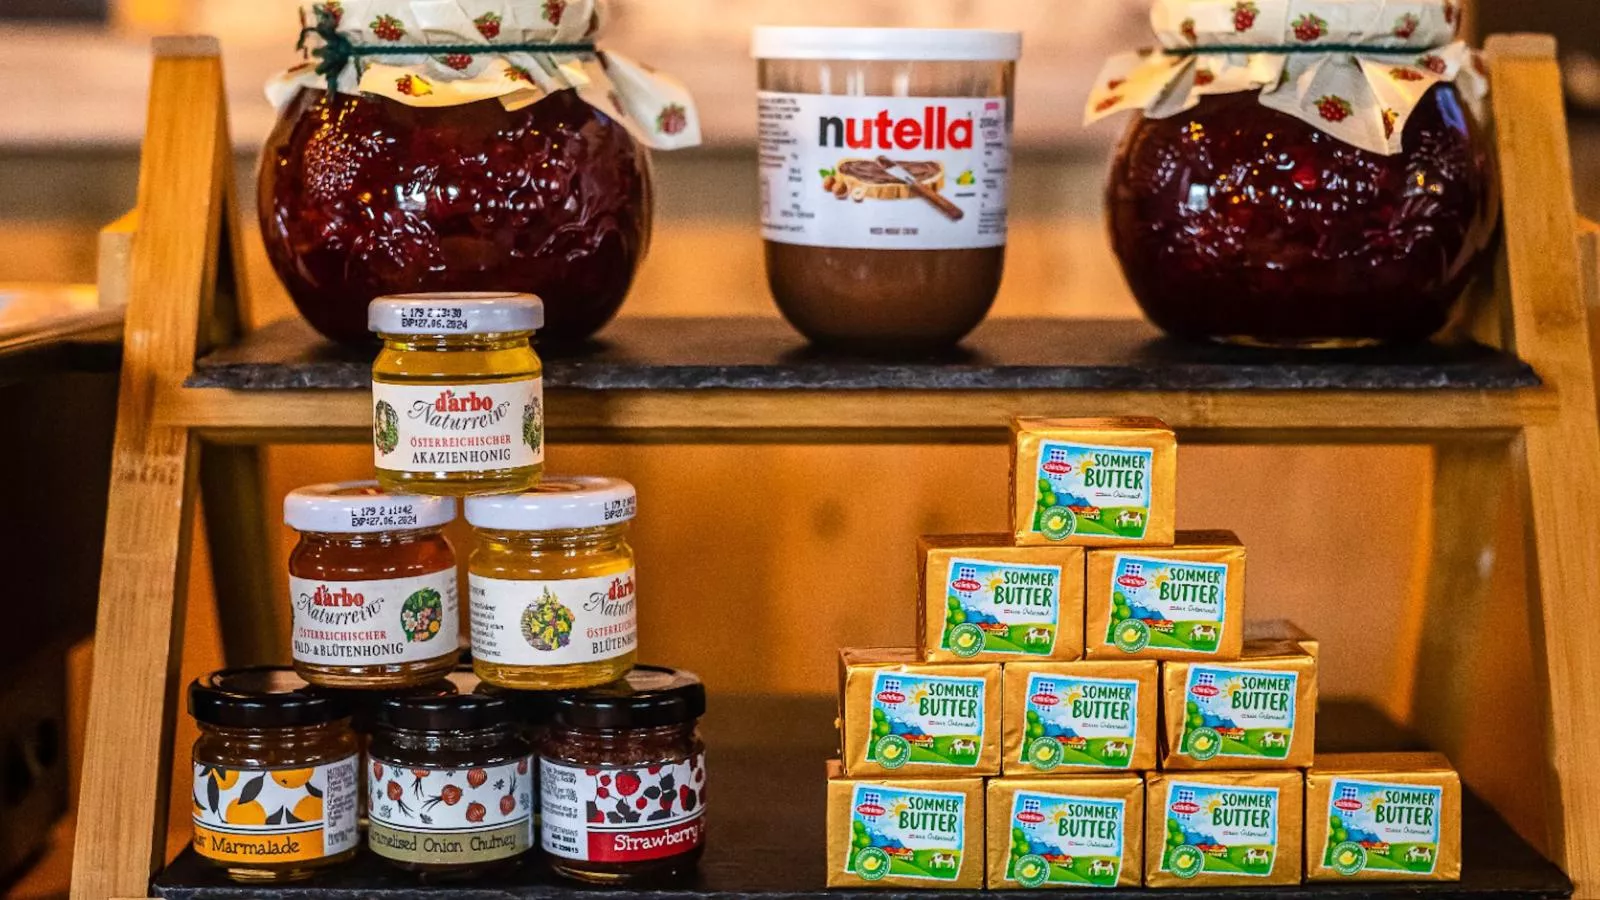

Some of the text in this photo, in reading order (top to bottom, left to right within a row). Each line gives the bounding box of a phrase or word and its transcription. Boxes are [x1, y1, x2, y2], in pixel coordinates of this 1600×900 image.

[819, 106, 973, 150] nutella
[410, 308, 424, 318] 179
[401, 318, 468, 330] EXP:27.06.2024
[407, 400, 511, 430] Naturrein
[410, 434, 511, 448] ÖSTERREICHISCHER
[412, 449, 511, 464] AKAZIENHONIG
[1094, 453, 1145, 469] SOMMER
[1084, 467, 1144, 490] BUTTER
[351, 506, 357, 517] L
[361, 507, 376, 517] 179
[379, 506, 386, 516] 2
[351, 514, 417, 527] EXP:27.06.2024
[1003, 571, 1054, 587] SOMMER
[1169, 568, 1220, 584] SOMMER
[994, 585, 1053, 608] BUTTER
[1159, 581, 1219, 604] BUTTER
[297, 592, 385, 626] Naturrein
[928, 683, 979, 698] SOMMER
[1082, 685, 1131, 701] SOMMER
[1241, 676, 1290, 692] SOMMER
[919, 697, 977, 719] BUTTER
[1072, 699, 1130, 721] BUTTER
[1232, 690, 1289, 712] BUTTER
[908, 796, 959, 813] SOMMER
[1222, 793, 1272, 808] SOMMER
[1385, 790, 1435, 806] SOMMER
[1068, 804, 1118, 819] SOMMER
[1212, 807, 1270, 829] BUTTER
[1375, 805, 1433, 826] BUTTER
[898, 811, 957, 833] BUTTER
[1058, 818, 1117, 840] BUTTER
[211, 835, 300, 856] Marmalade
[423, 837, 463, 853] Onion
[470, 833, 516, 850] Chutney
[613, 826, 698, 851] Strawberry
